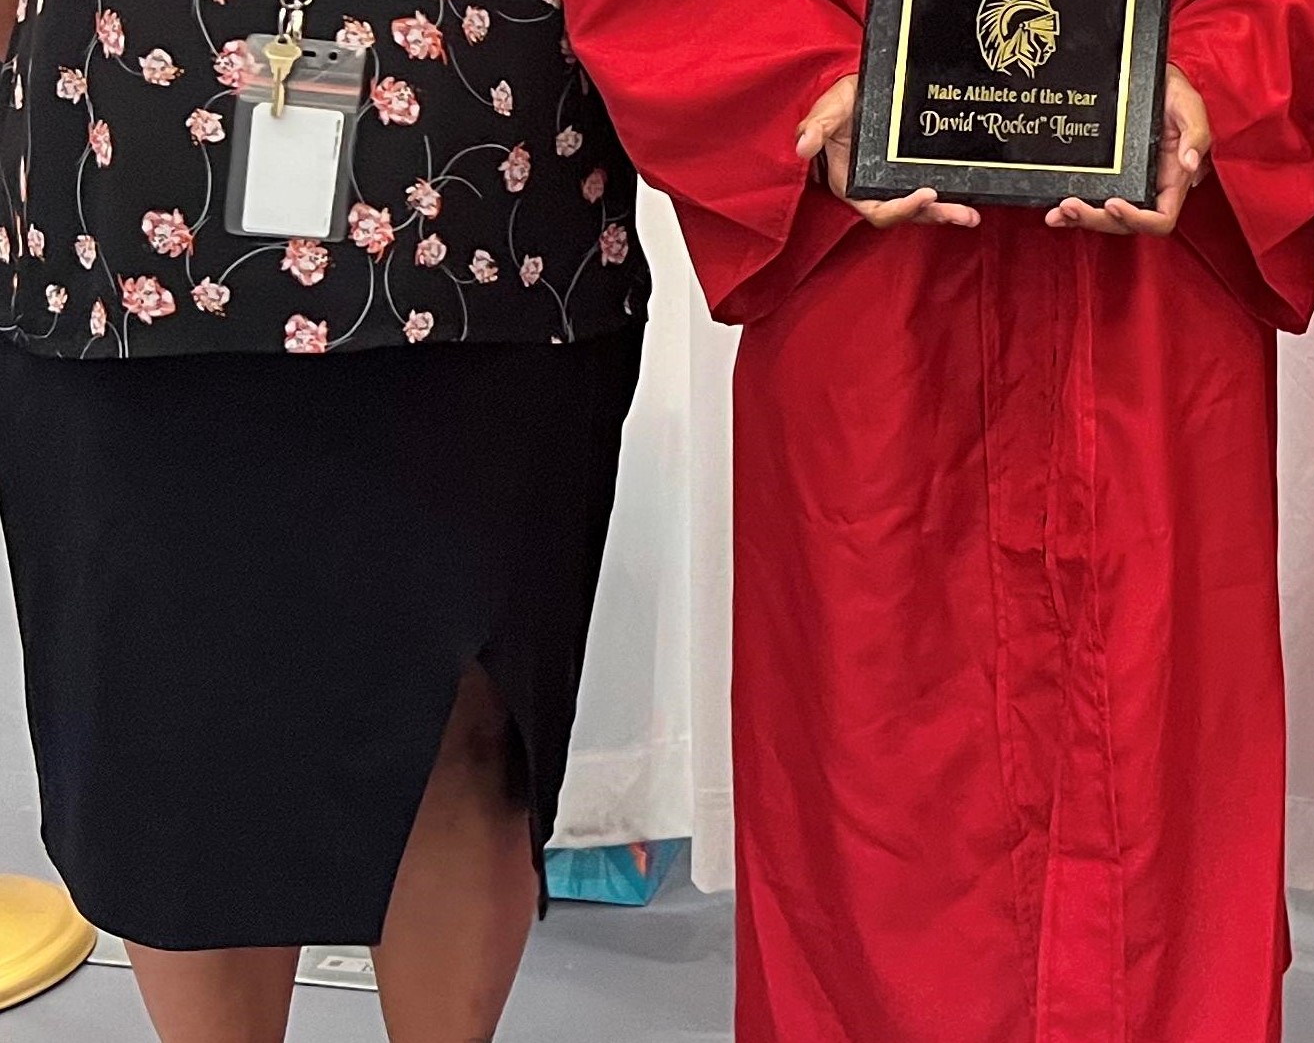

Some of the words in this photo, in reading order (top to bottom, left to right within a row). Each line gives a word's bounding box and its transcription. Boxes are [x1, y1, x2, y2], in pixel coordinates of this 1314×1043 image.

[927, 84, 962, 100] Male
[964, 85, 1018, 103] Athlete
[1020, 88, 1037, 104] of
[1040, 89, 1063, 104] the
[1066, 89, 1098, 106] Year
[919, 110, 975, 137] David
